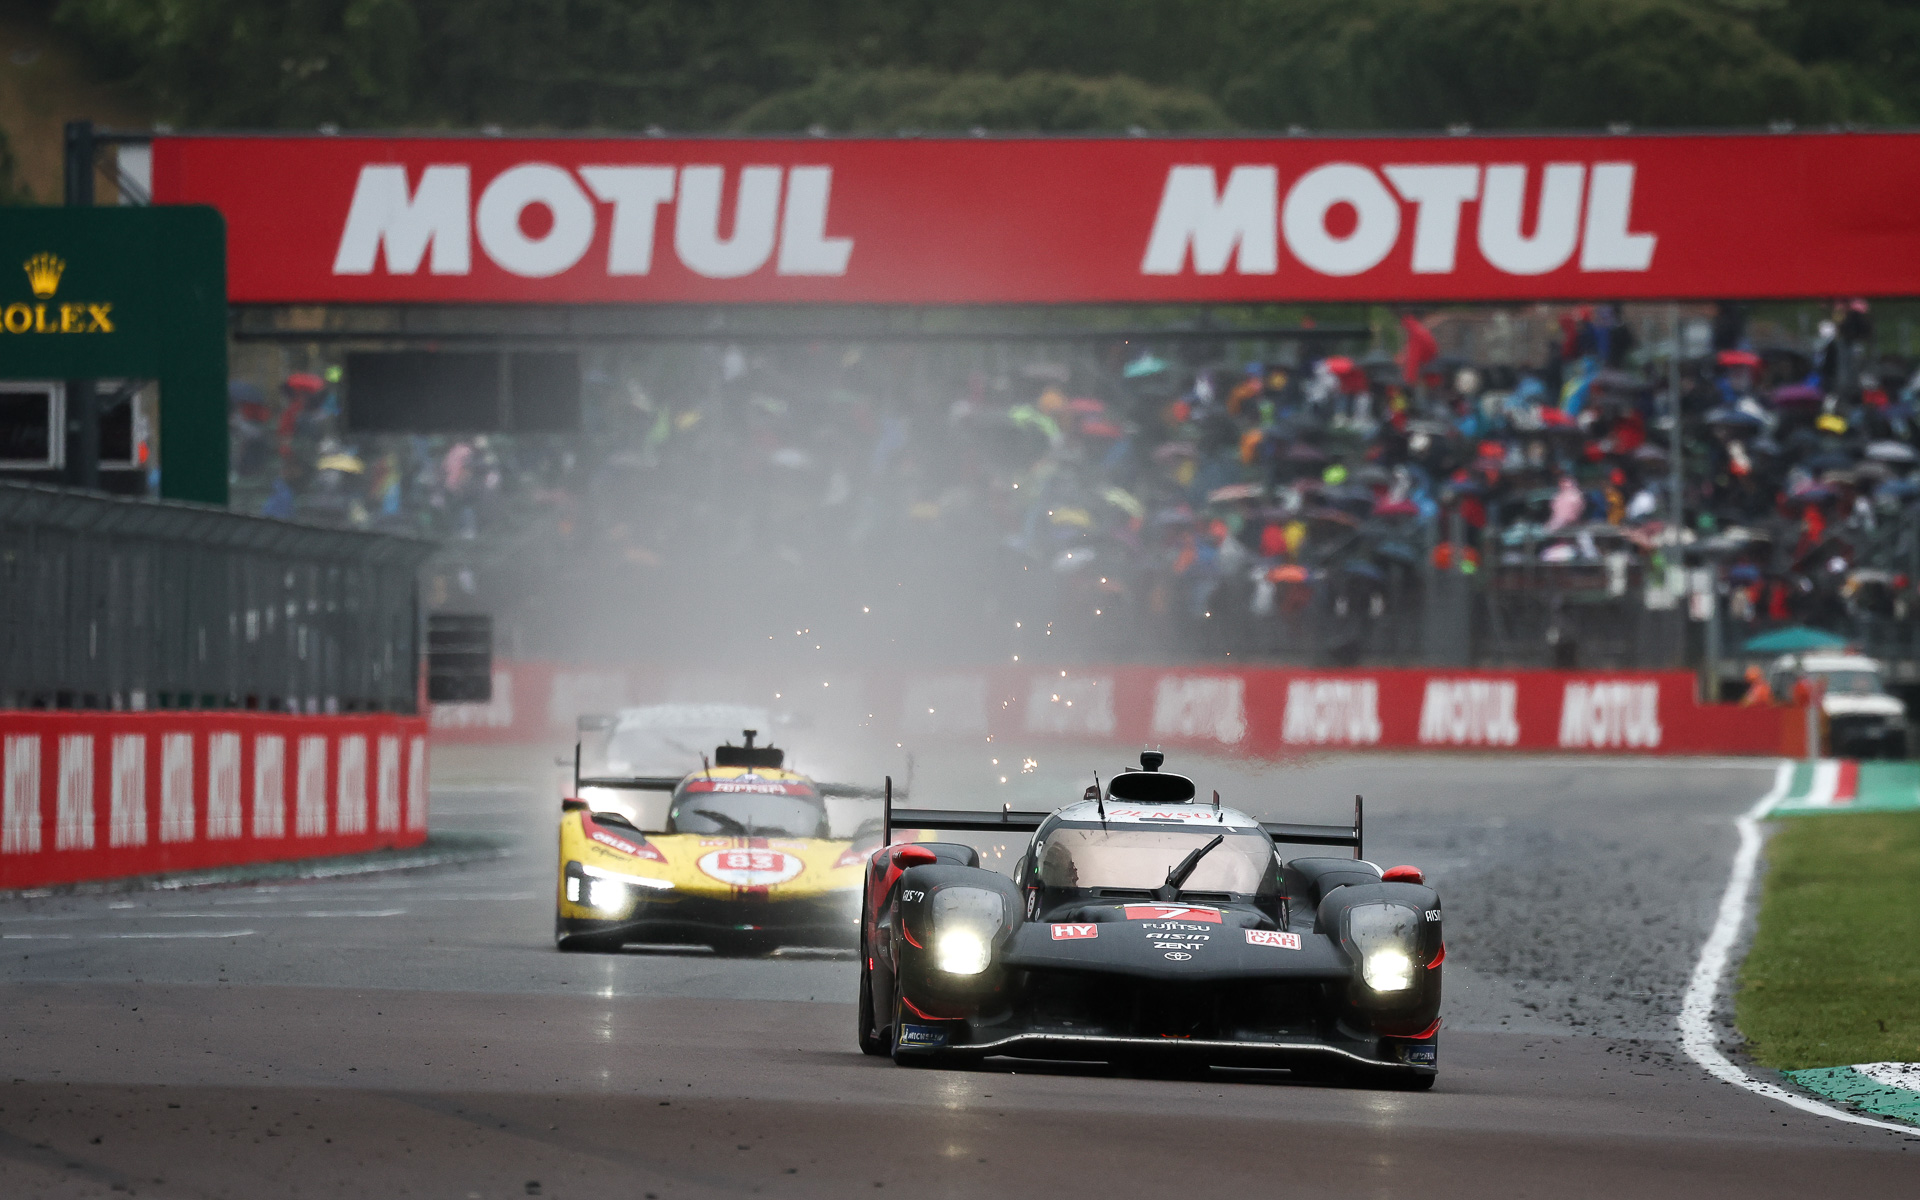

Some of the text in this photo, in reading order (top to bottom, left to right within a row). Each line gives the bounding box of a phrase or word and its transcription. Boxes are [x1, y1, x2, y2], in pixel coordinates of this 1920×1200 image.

[332, 161, 855, 278] MOTUL
[1140, 161, 1657, 277] MOTUL
[0, 302, 114, 334] OLEX
[1108, 808, 1212, 820] DENSO
[727, 854, 774, 869] 83
[1154, 907, 1191, 919] 7
[1054, 925, 1093, 937] HY
[1142, 920, 1211, 932] FUJITSU
[1153, 941, 1204, 951] ZENT
[1251, 935, 1296, 947] CAR
